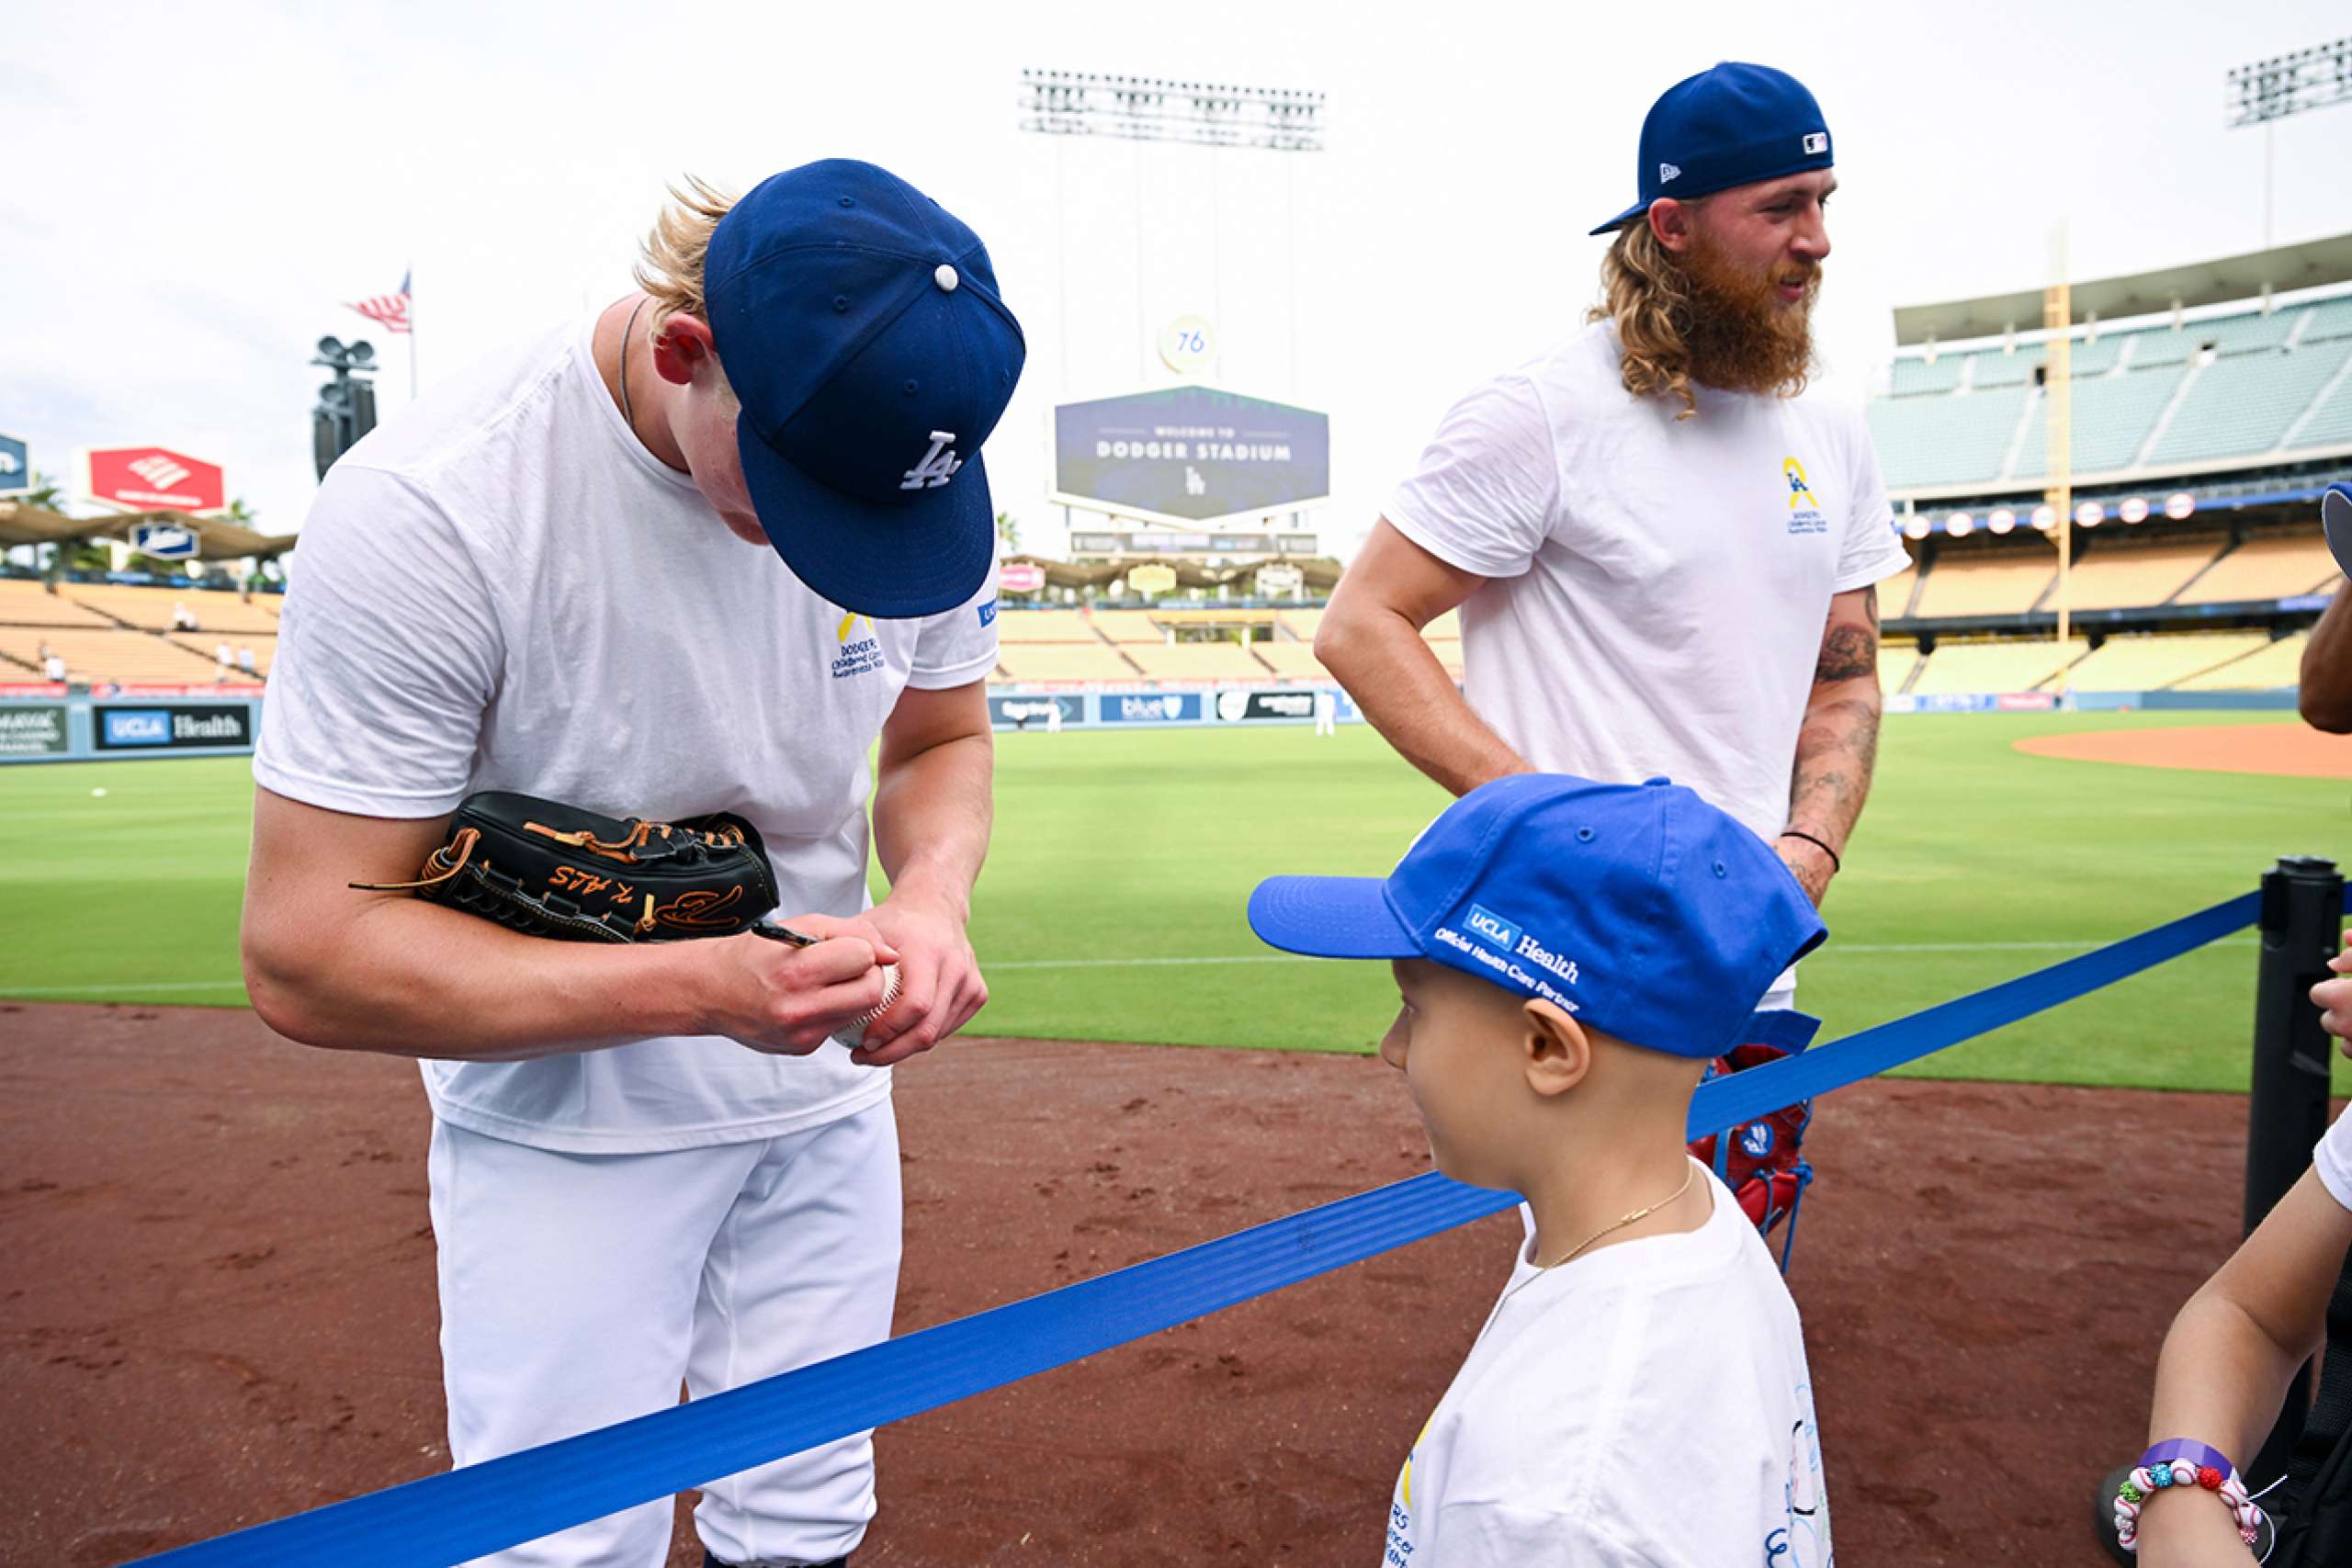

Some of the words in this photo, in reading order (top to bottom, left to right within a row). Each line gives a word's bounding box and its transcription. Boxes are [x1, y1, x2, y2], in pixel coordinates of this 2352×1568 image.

[1178, 329, 1204, 353] 76
[1154, 426, 1215, 438] WELCOME
[1218, 427, 1236, 439] TO
[899, 429, 962, 490] LA
[1096, 440, 1188, 459] DODGER
[1196, 442, 1292, 460] STADIUM
[112, 716, 164, 738] UCLA
[174, 715, 242, 738] Health
[1471, 912, 1510, 944] UCLA
[1516, 935, 1579, 985] Health
[1434, 928, 1473, 953] Official
[1472, 946, 1508, 973] Health
[1507, 964, 1536, 988] Care
[1535, 981, 1579, 1011] Partner
